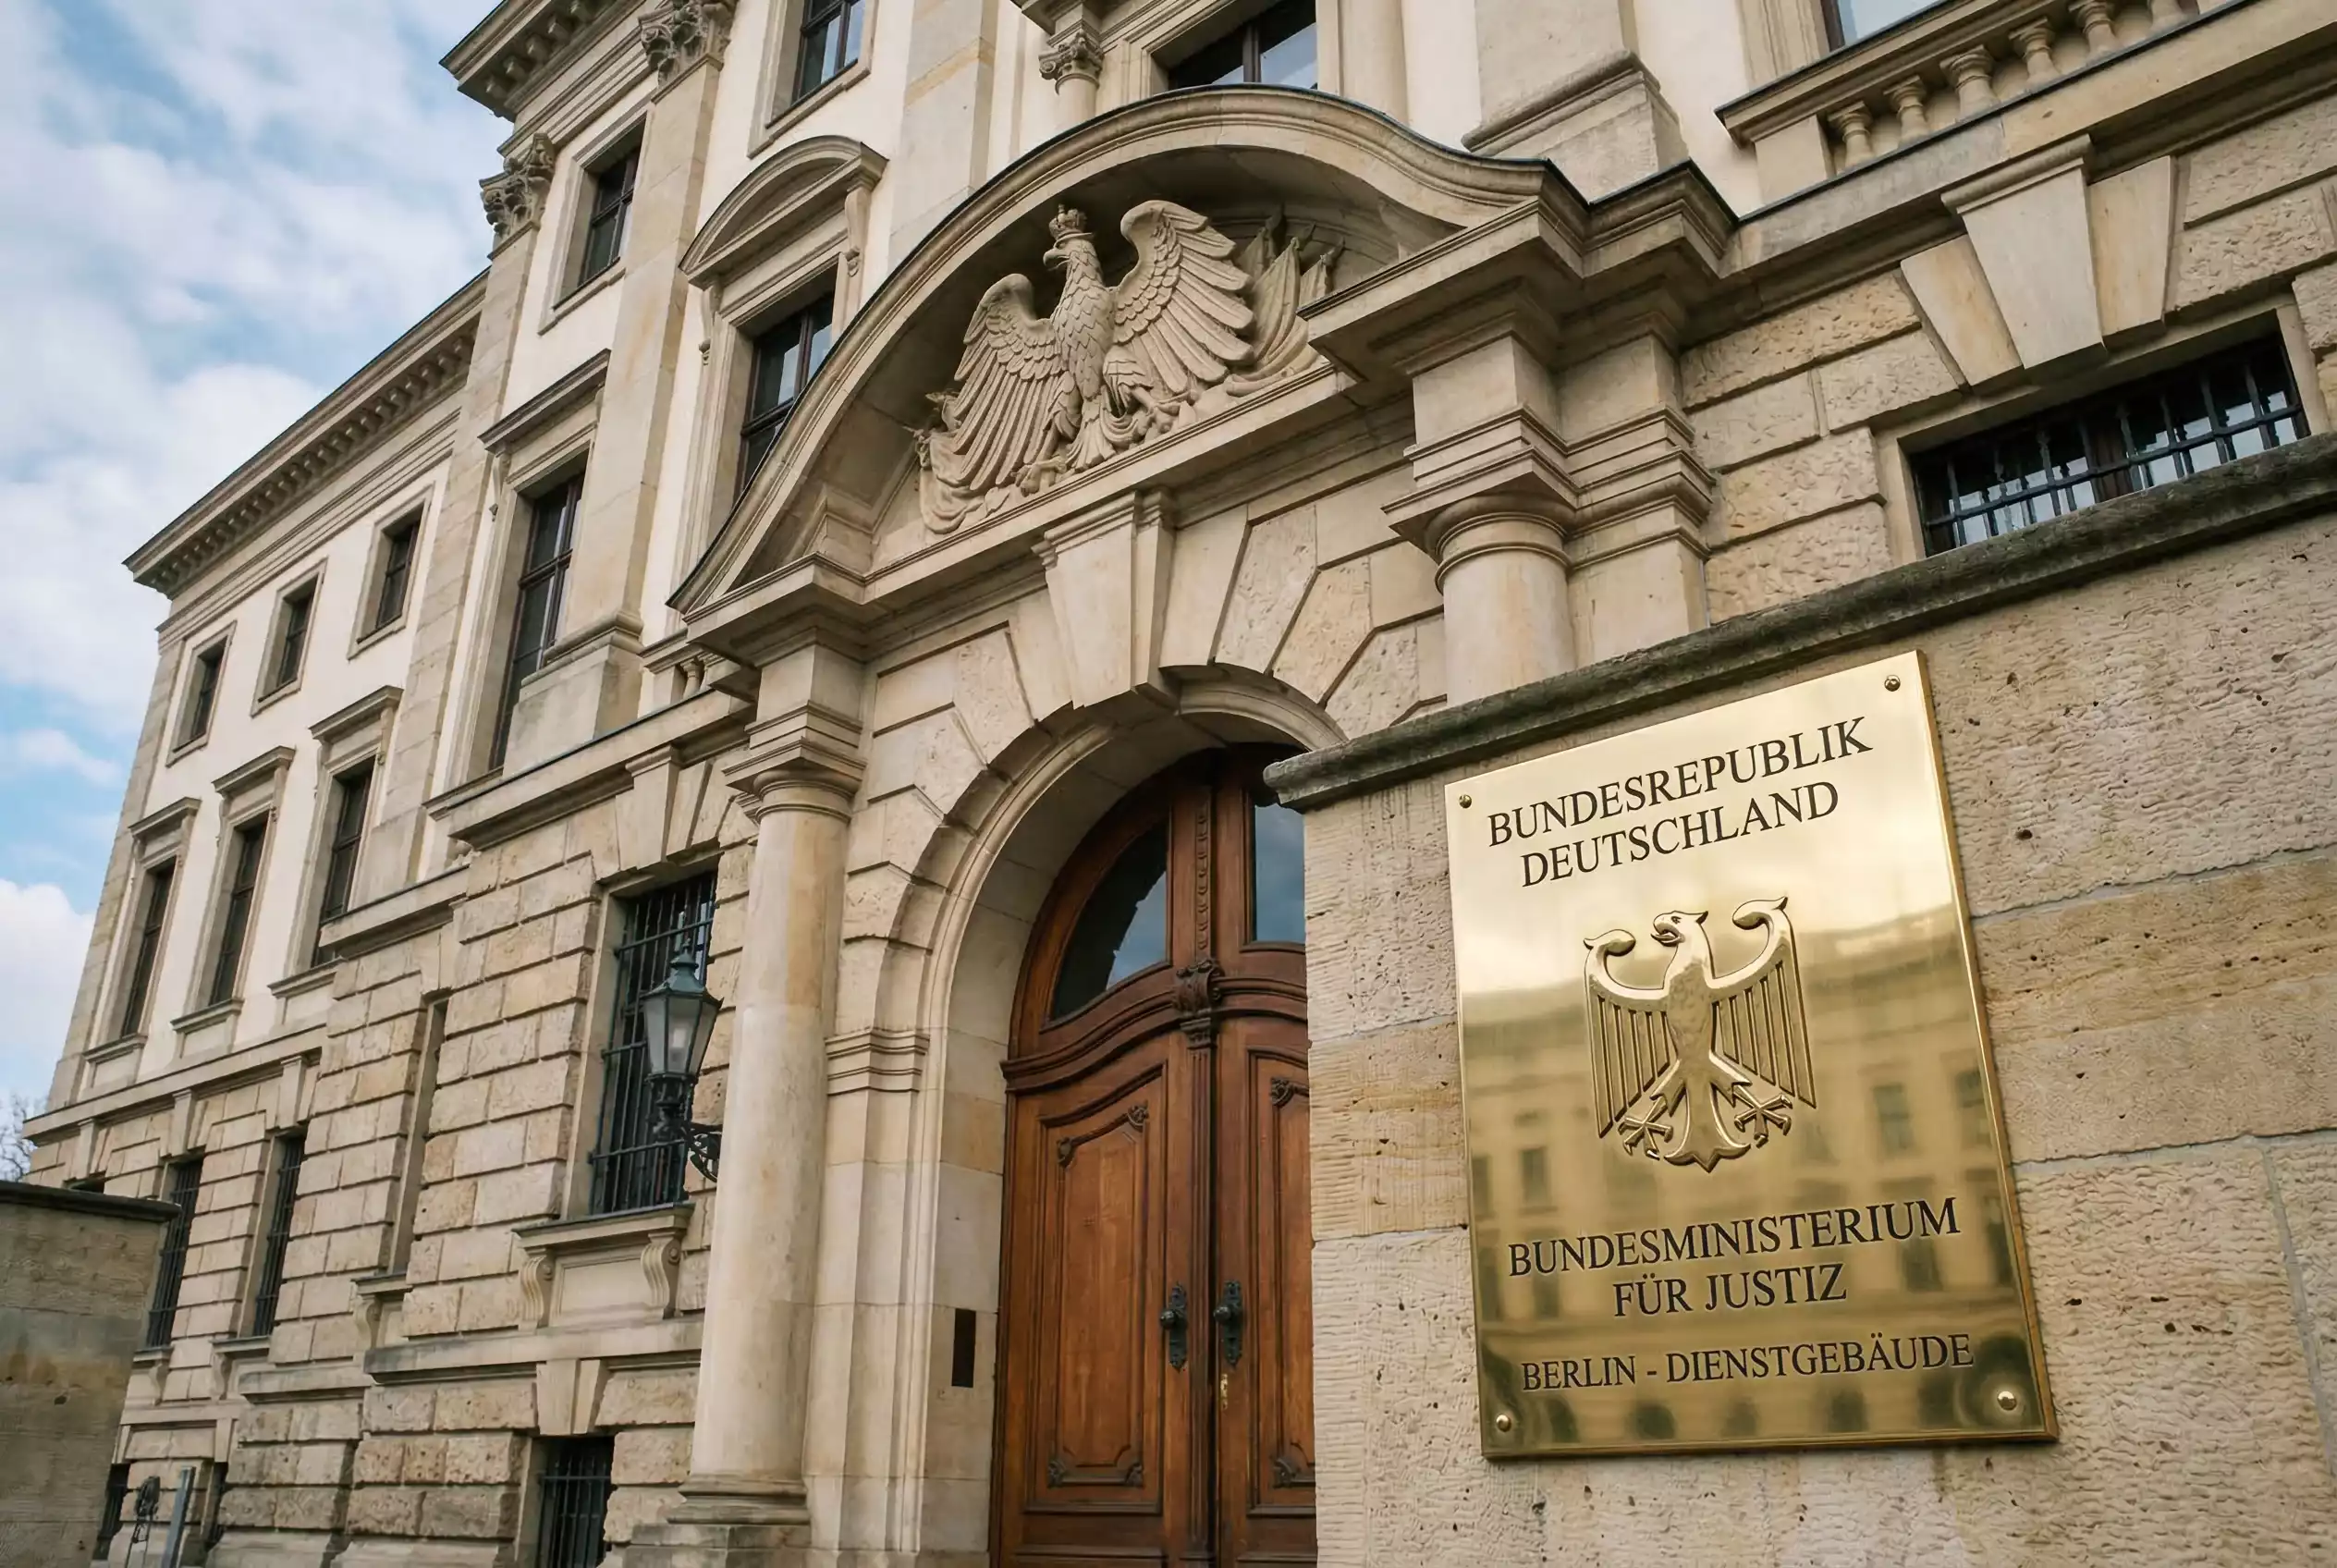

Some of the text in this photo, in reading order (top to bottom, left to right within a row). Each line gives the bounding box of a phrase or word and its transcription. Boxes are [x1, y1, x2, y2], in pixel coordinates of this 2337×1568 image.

[1487, 717, 1873, 847] BUNDESREPUBLIK
[1521, 780, 1839, 888] DEUTSCHLAND
[1509, 1196, 1961, 1277] BUNDESMINISTERIUM
[1613, 1263, 1848, 1317] FÜR JUSTIZ
[1522, 1354, 1636, 1391] BERLIN
[1666, 1332, 1975, 1384] DIENSTGEBÄUDE
